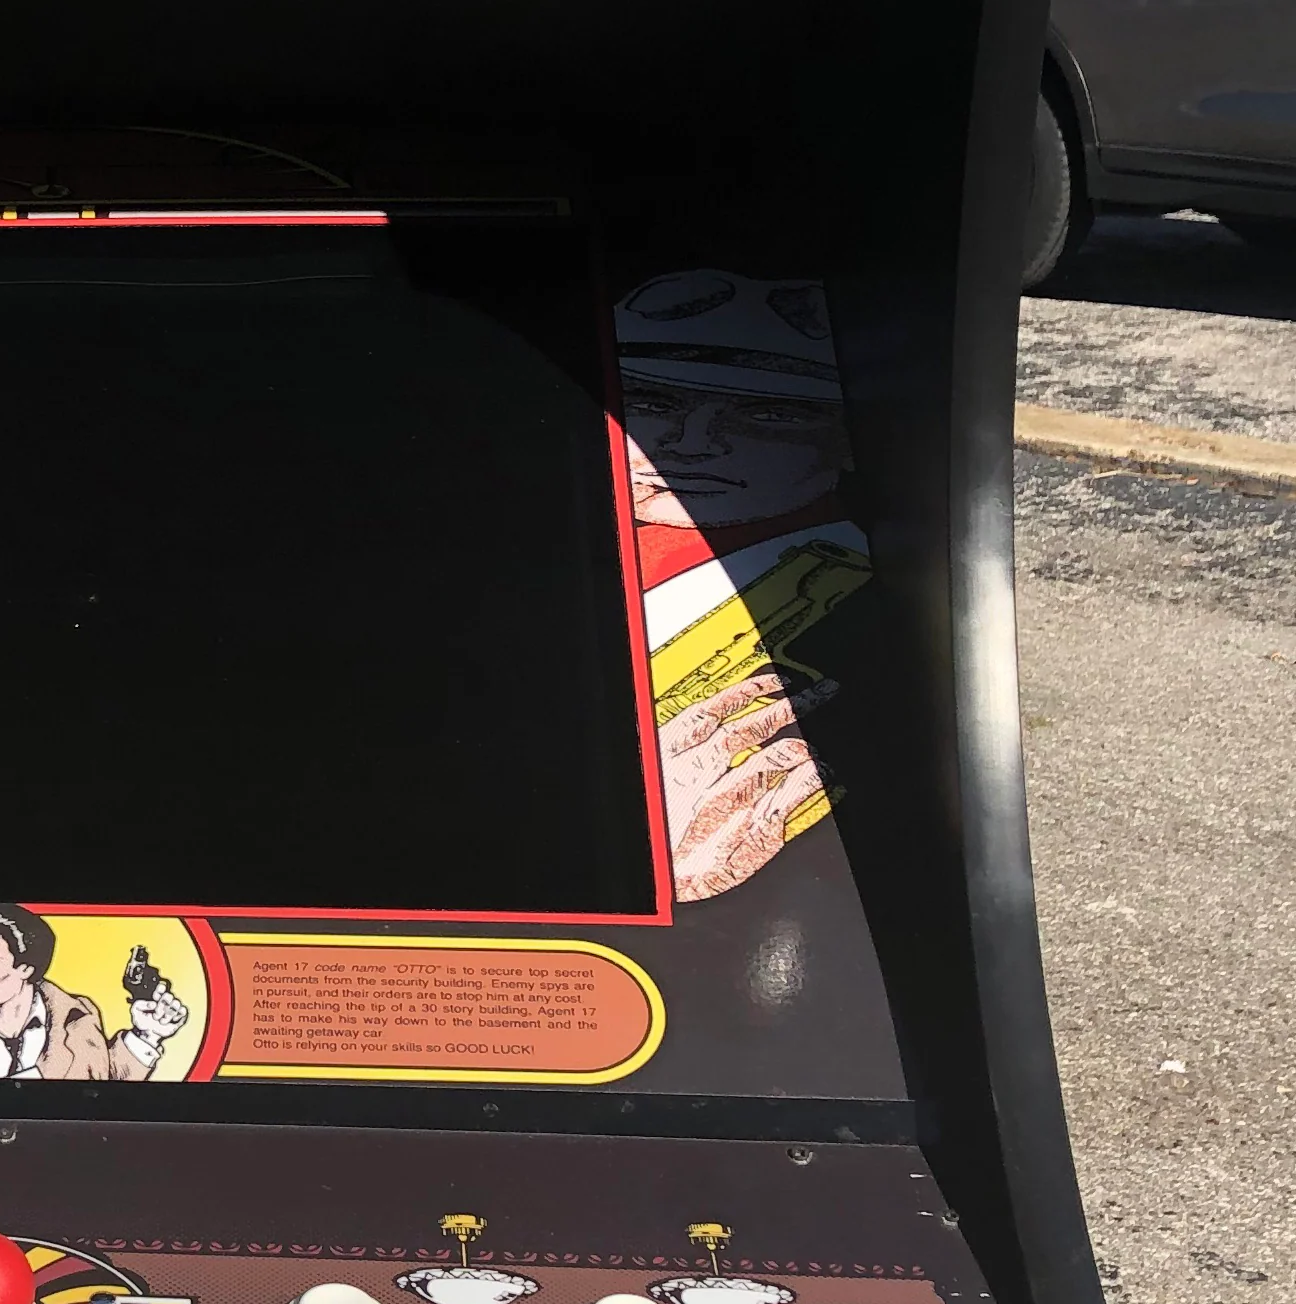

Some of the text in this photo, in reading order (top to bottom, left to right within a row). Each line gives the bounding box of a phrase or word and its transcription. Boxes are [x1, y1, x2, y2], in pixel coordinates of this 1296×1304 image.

[253, 961, 288, 973] Agent
[295, 962, 309, 971] 17
[315, 963, 345, 972] code
[351, 964, 386, 973] name
[447, 965, 456, 974] is
[463, 966, 474, 975] to
[480, 967, 523, 976] secure
[529, 967, 549, 978] top
[554, 969, 594, 978] secret
[253, 975, 595, 991] documents from the security Enemy spys are
[253, 988, 551, 1004] in and their orders are to stop him at any
[253, 999, 597, 1018] After reaching the tip of a 30 story Agent 17
[253, 1013, 597, 1030] has to make his way down to the basement and the
[253, 1026, 359, 1039] awaiting getaway
[253, 1038, 279, 1049] Otto
[282, 1040, 293, 1049] is
[296, 1040, 337, 1052] relying
[341, 1042, 357, 1051] on
[361, 1043, 387, 1053] your
[392, 1042, 422, 1052] skills
[426, 1043, 441, 1053] so
[445, 1042, 489, 1054] GOOD
